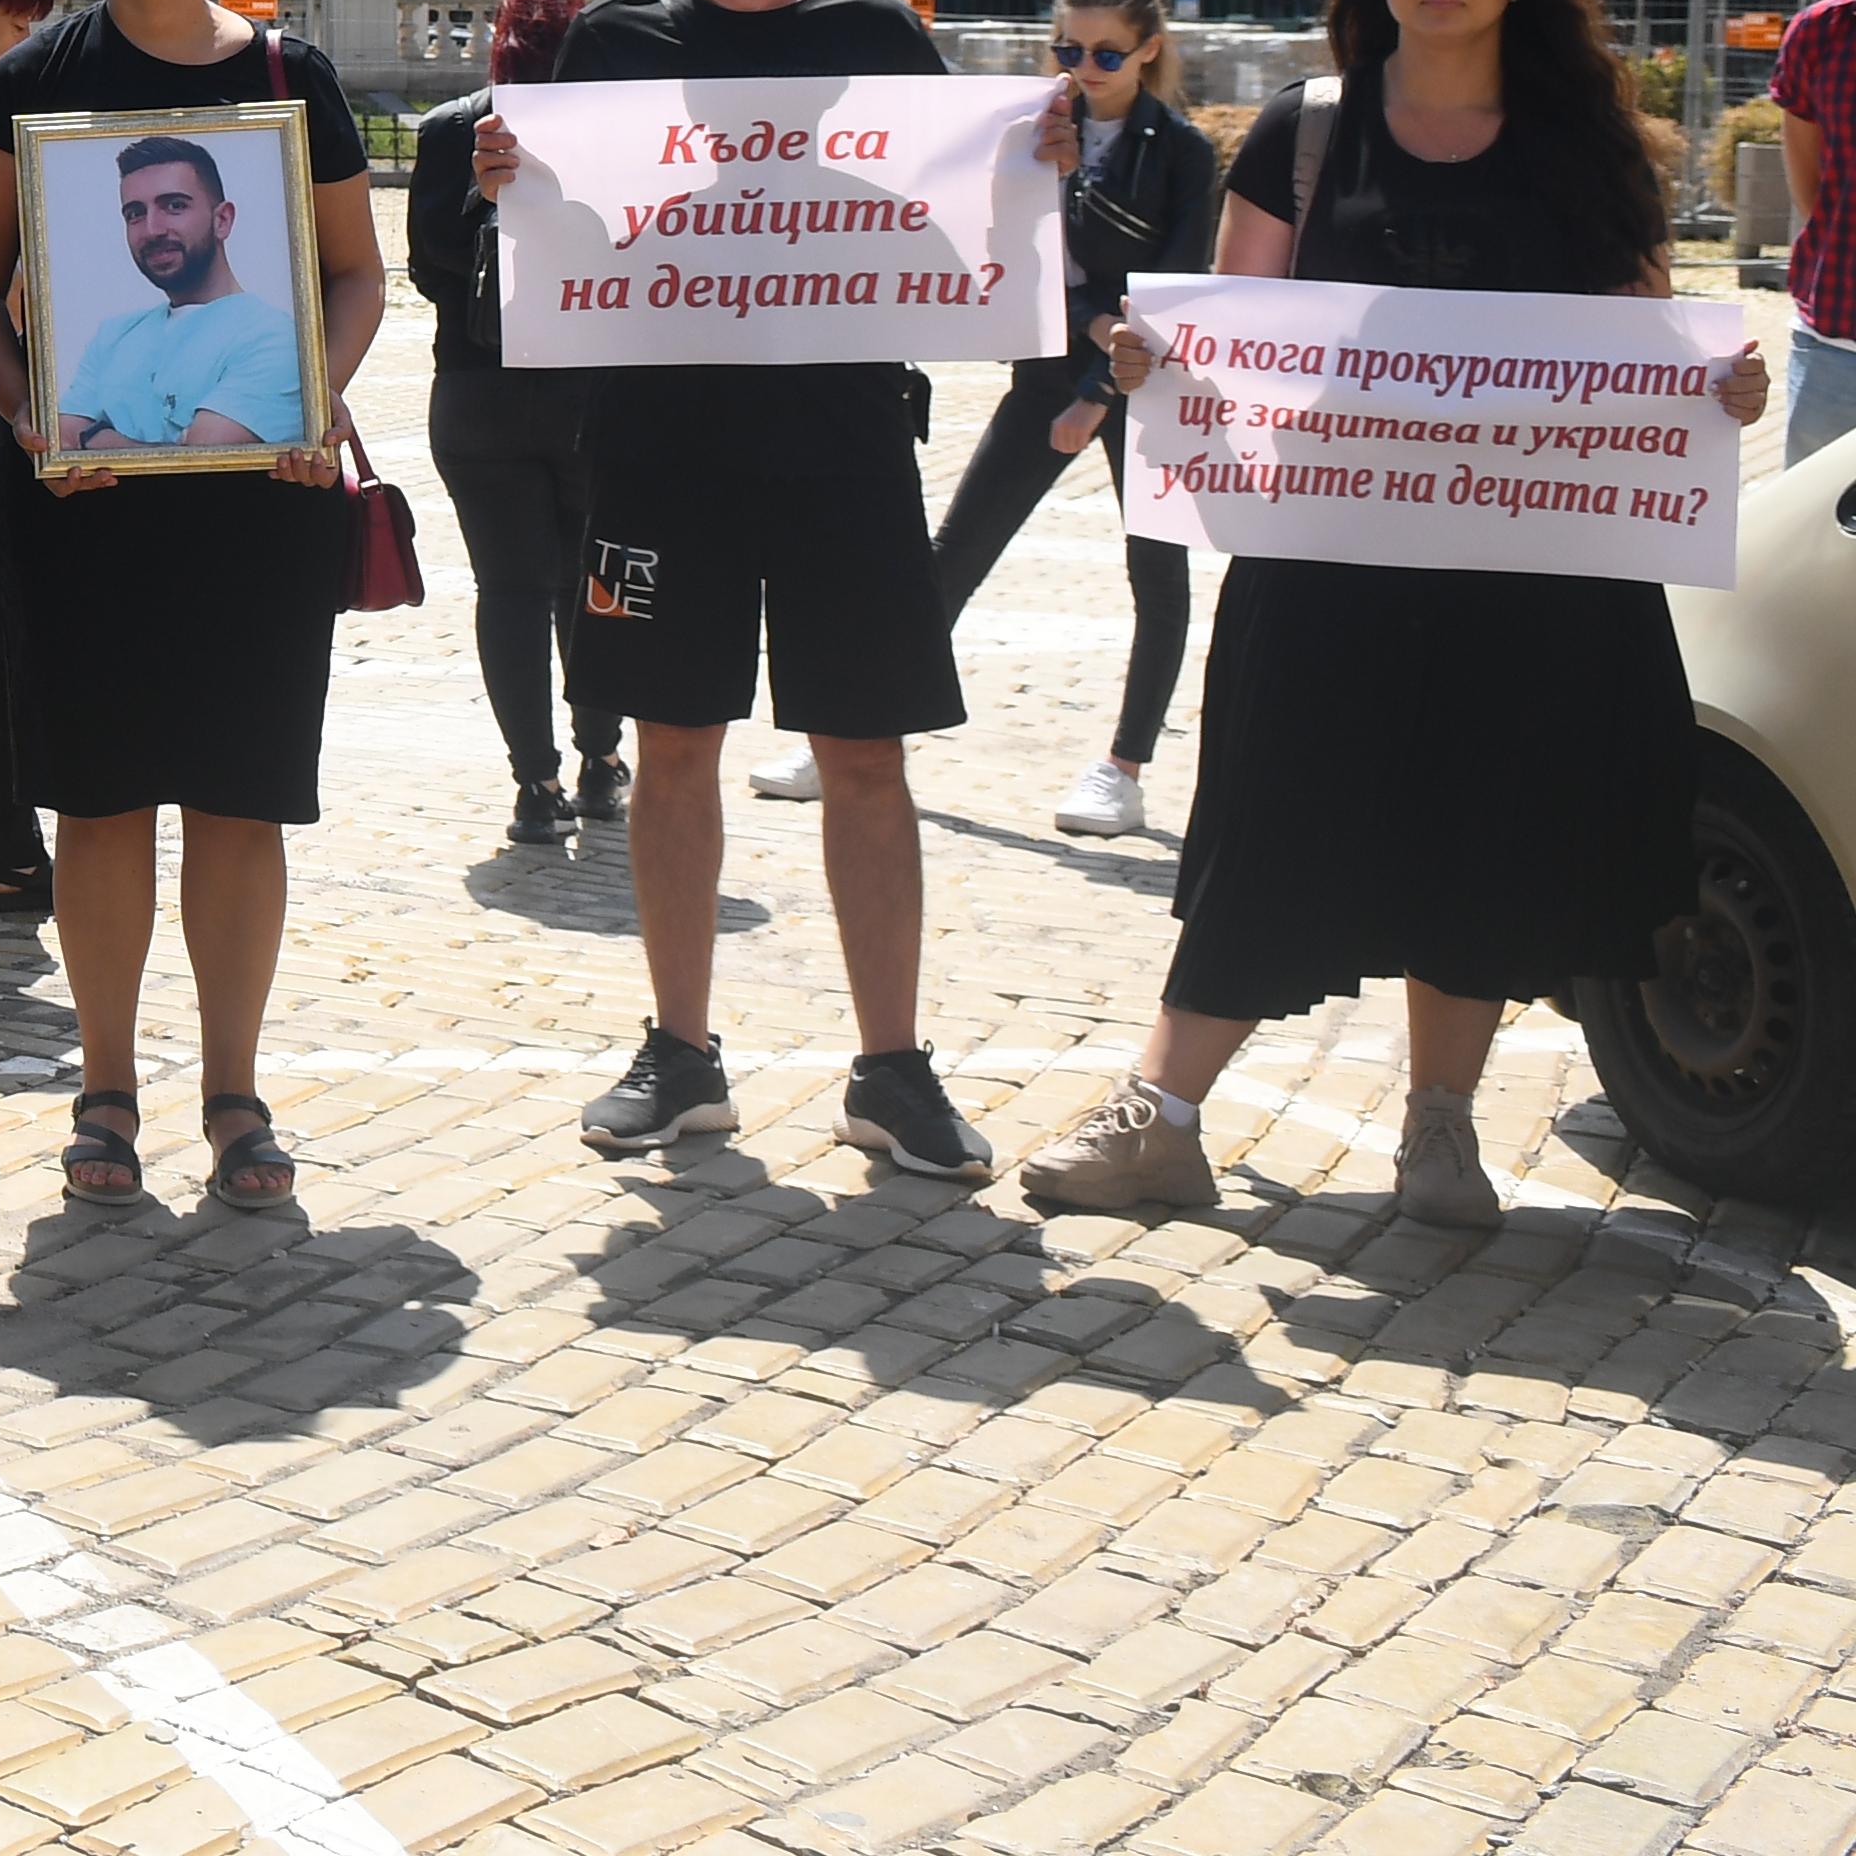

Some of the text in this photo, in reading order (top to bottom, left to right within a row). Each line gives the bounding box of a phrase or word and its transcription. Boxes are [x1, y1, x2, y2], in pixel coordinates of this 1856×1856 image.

[659, 121, 890, 165] Къде са
[616, 188, 930, 250] убийците
[560, 263, 1004, 318] на децата ни?
[1161, 322, 1708, 404] До кога прокуратурата
[1179, 394, 1689, 458] ще защитава и укрива
[1155, 451, 1708, 526] убийците на децата ни?
